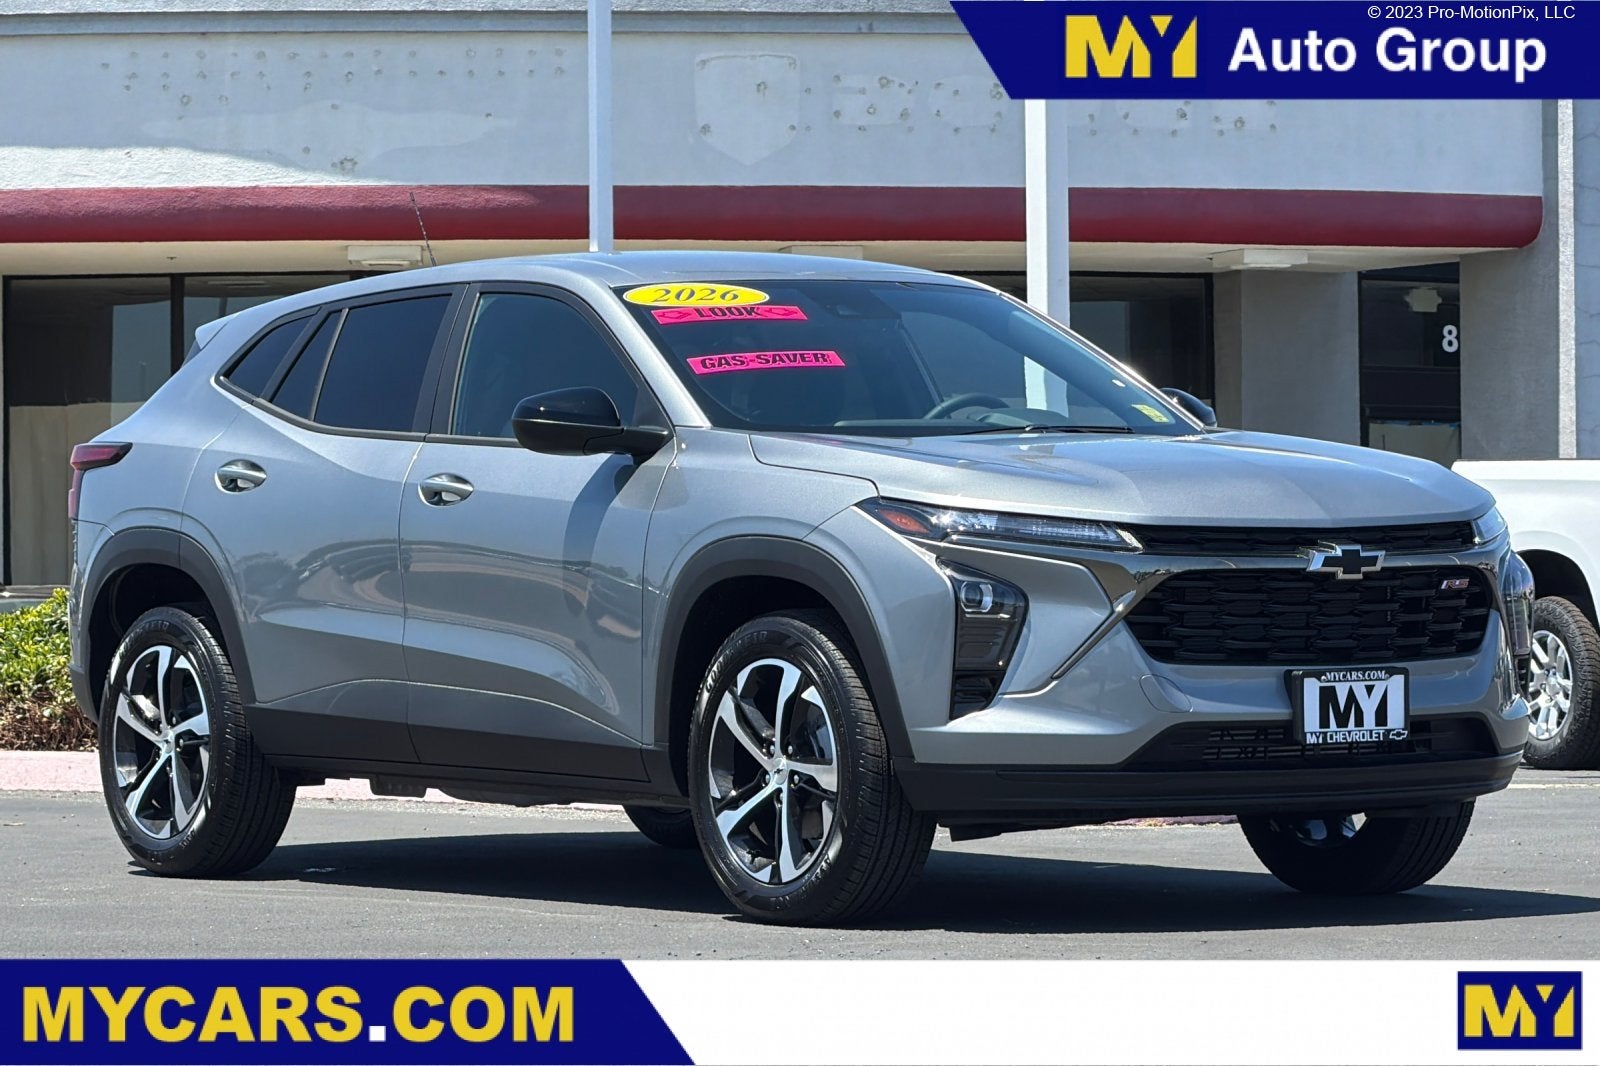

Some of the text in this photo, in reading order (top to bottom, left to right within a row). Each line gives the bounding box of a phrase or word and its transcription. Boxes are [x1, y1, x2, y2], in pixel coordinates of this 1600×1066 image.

[651, 287, 740, 303] 2026
[693, 306, 763, 318] LOOK
[1441, 324, 1459, 353] 8
[700, 352, 830, 370] GAS-SAVER
[1325, 670, 1386, 681] MYCARS.COM
[1318, 683, 1389, 730] MY
[1306, 730, 1384, 745] MY CHEVROLET
